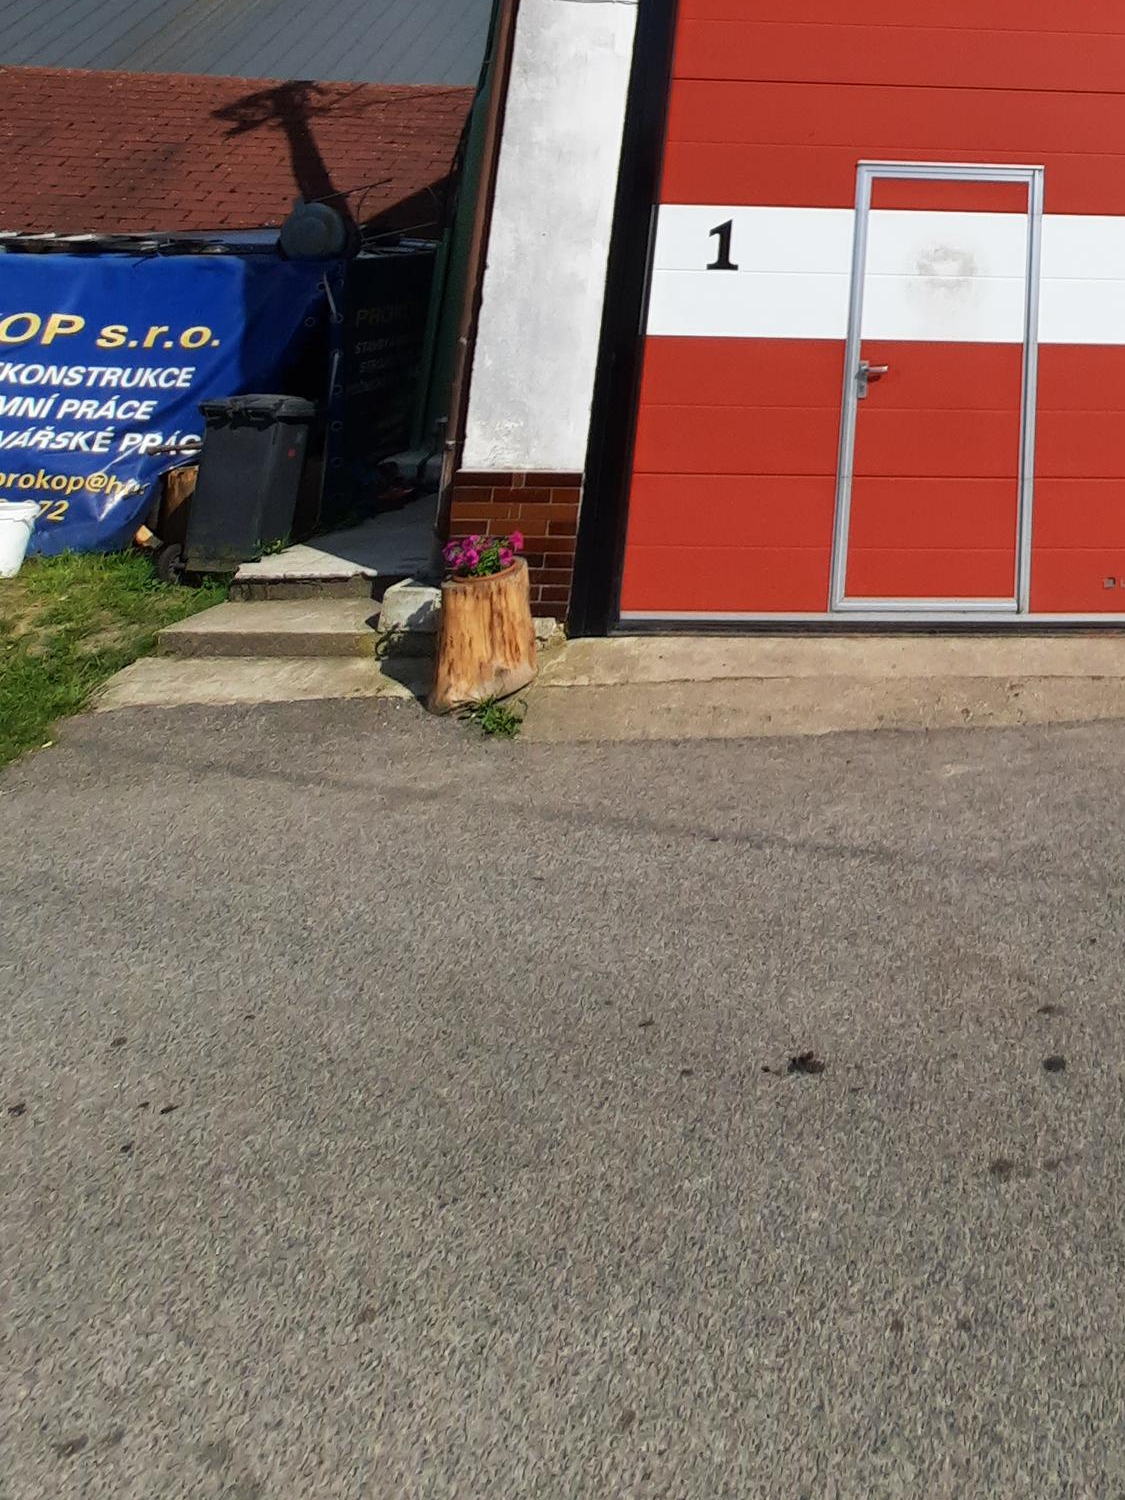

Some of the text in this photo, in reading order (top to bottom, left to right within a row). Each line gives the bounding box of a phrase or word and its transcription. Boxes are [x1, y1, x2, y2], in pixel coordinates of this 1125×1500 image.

[706, 218, 739, 271] 1
[96, 324, 220, 348] s.r.o.
[0, 361, 196, 388] KONSTRUKCE
[56, 395, 157, 420] PRÁCE
